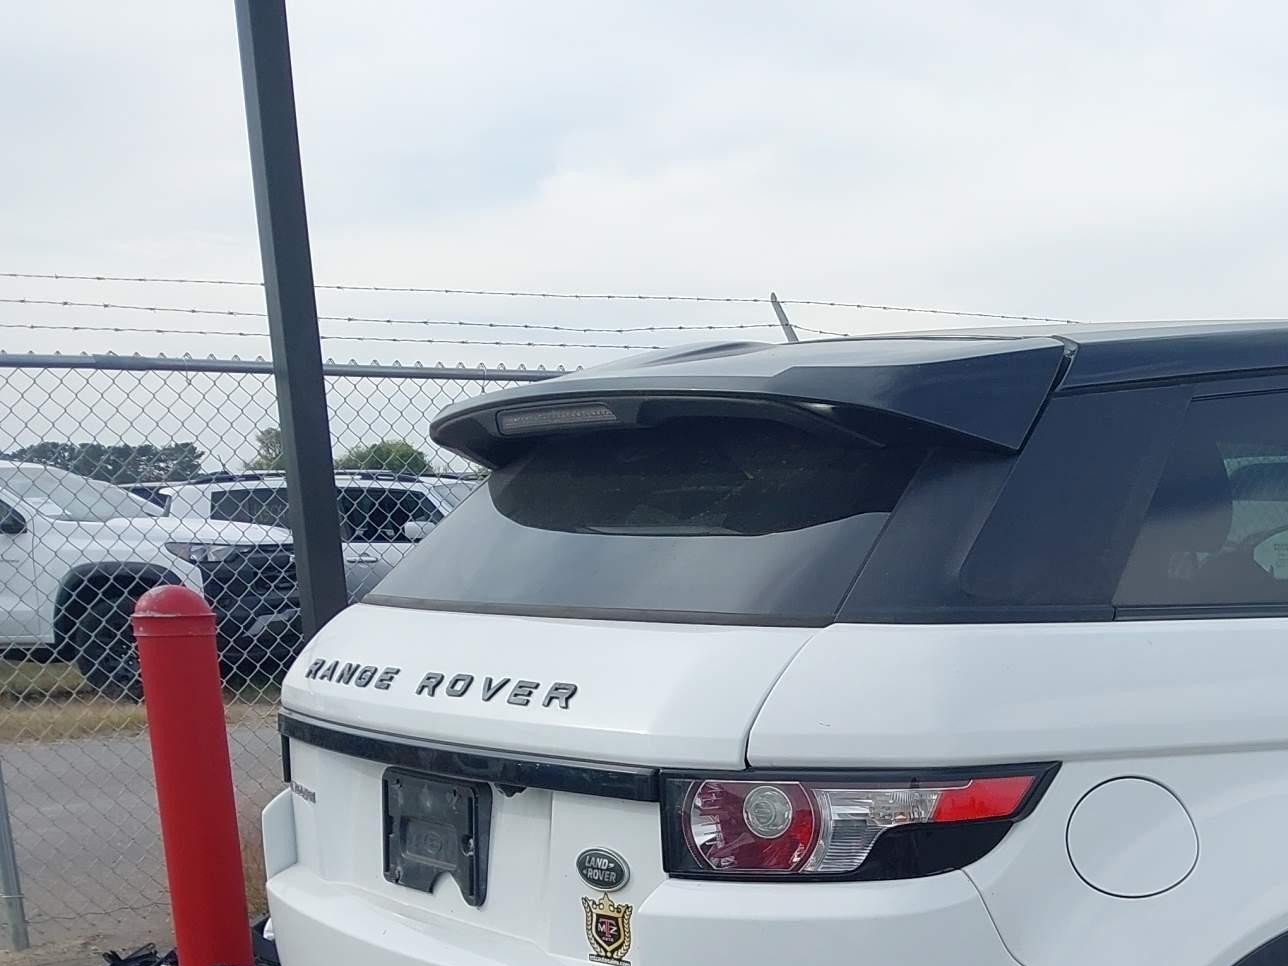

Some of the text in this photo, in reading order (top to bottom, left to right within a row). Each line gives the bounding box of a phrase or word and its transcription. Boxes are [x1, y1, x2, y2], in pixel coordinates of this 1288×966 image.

[305, 658, 578, 710] RANGE ROVER
[585, 855, 609, 870] LAND
[587, 868, 617, 883] ROVER
